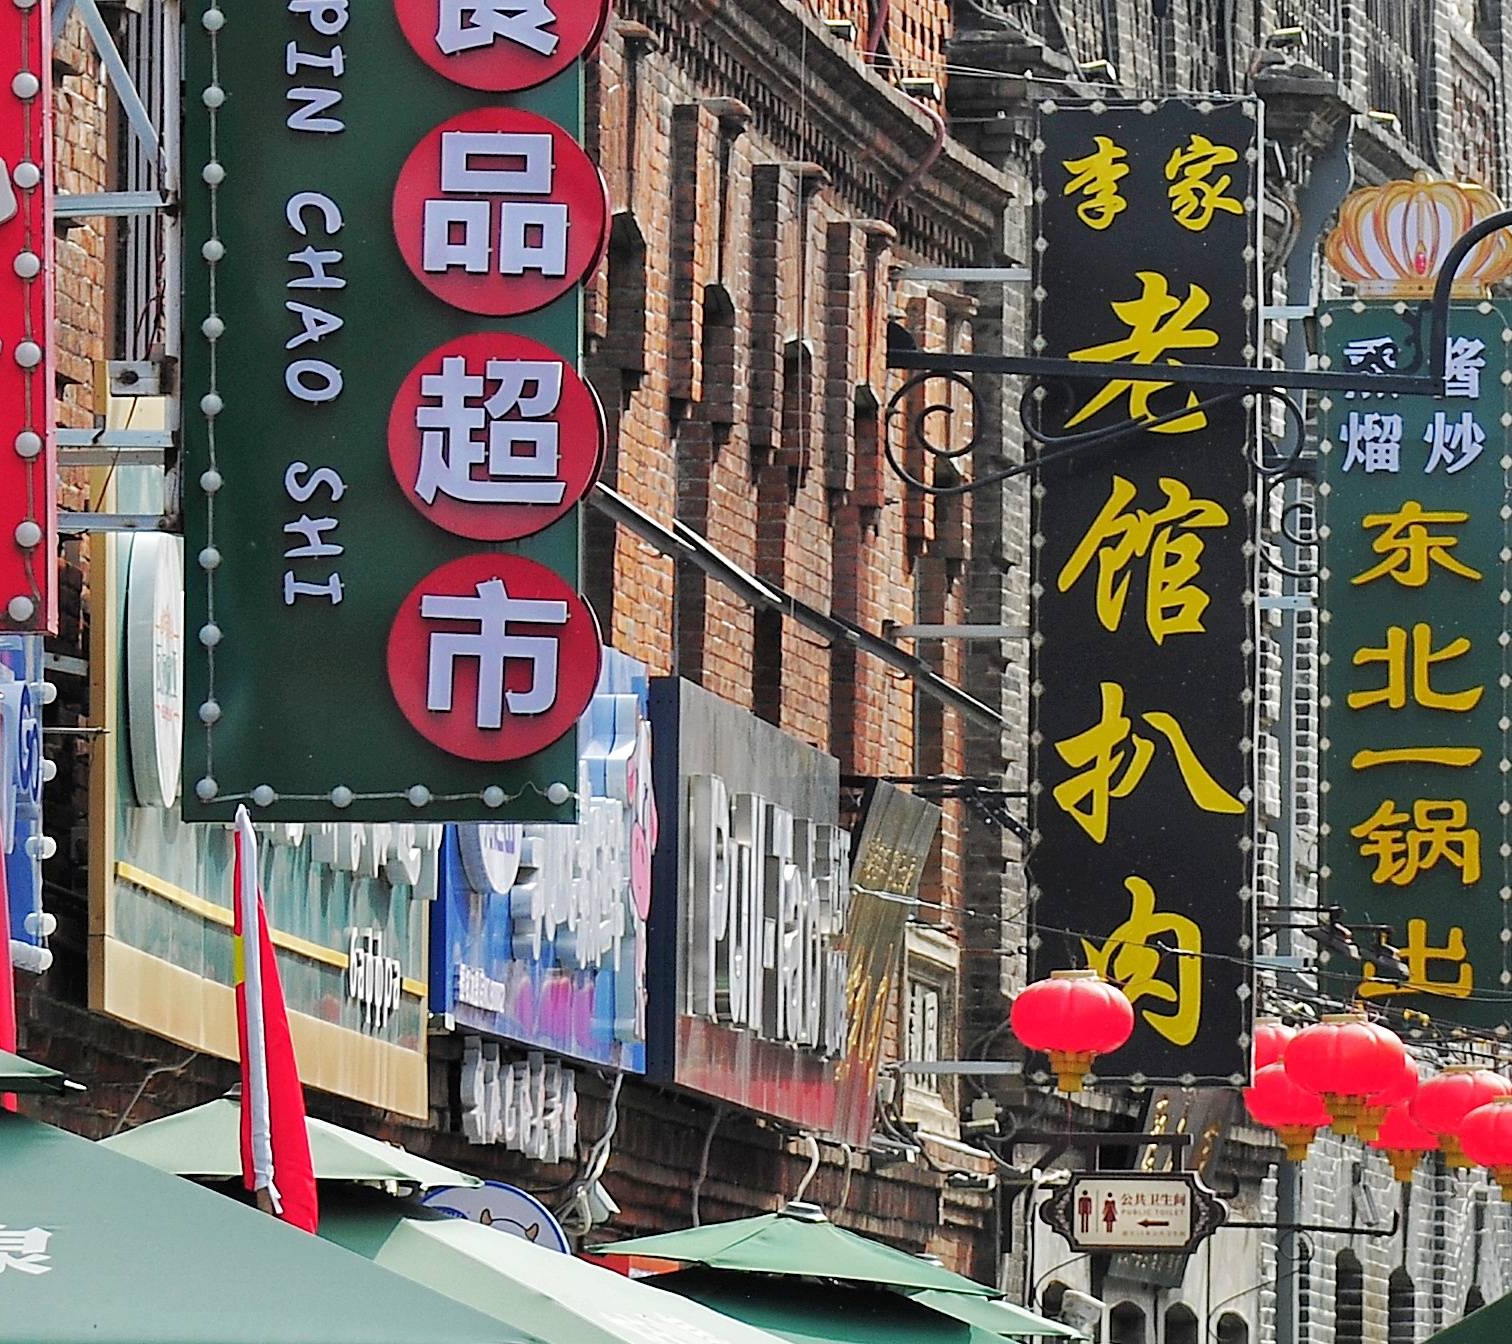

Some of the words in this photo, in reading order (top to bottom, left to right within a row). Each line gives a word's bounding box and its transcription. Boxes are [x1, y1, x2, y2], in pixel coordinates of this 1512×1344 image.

[1061, 133, 1246, 232] 李家
[286, 191, 346, 403] CHAO
[1339, 411, 1487, 475] 熘炒
[284, 461, 342, 607] SHI
[1052, 271, 1247, 1046] 老馆扒肉
[1347, 501, 1485, 1000] 东北一锅出
[1121, 1192, 1186, 1206] 公共卫生间
